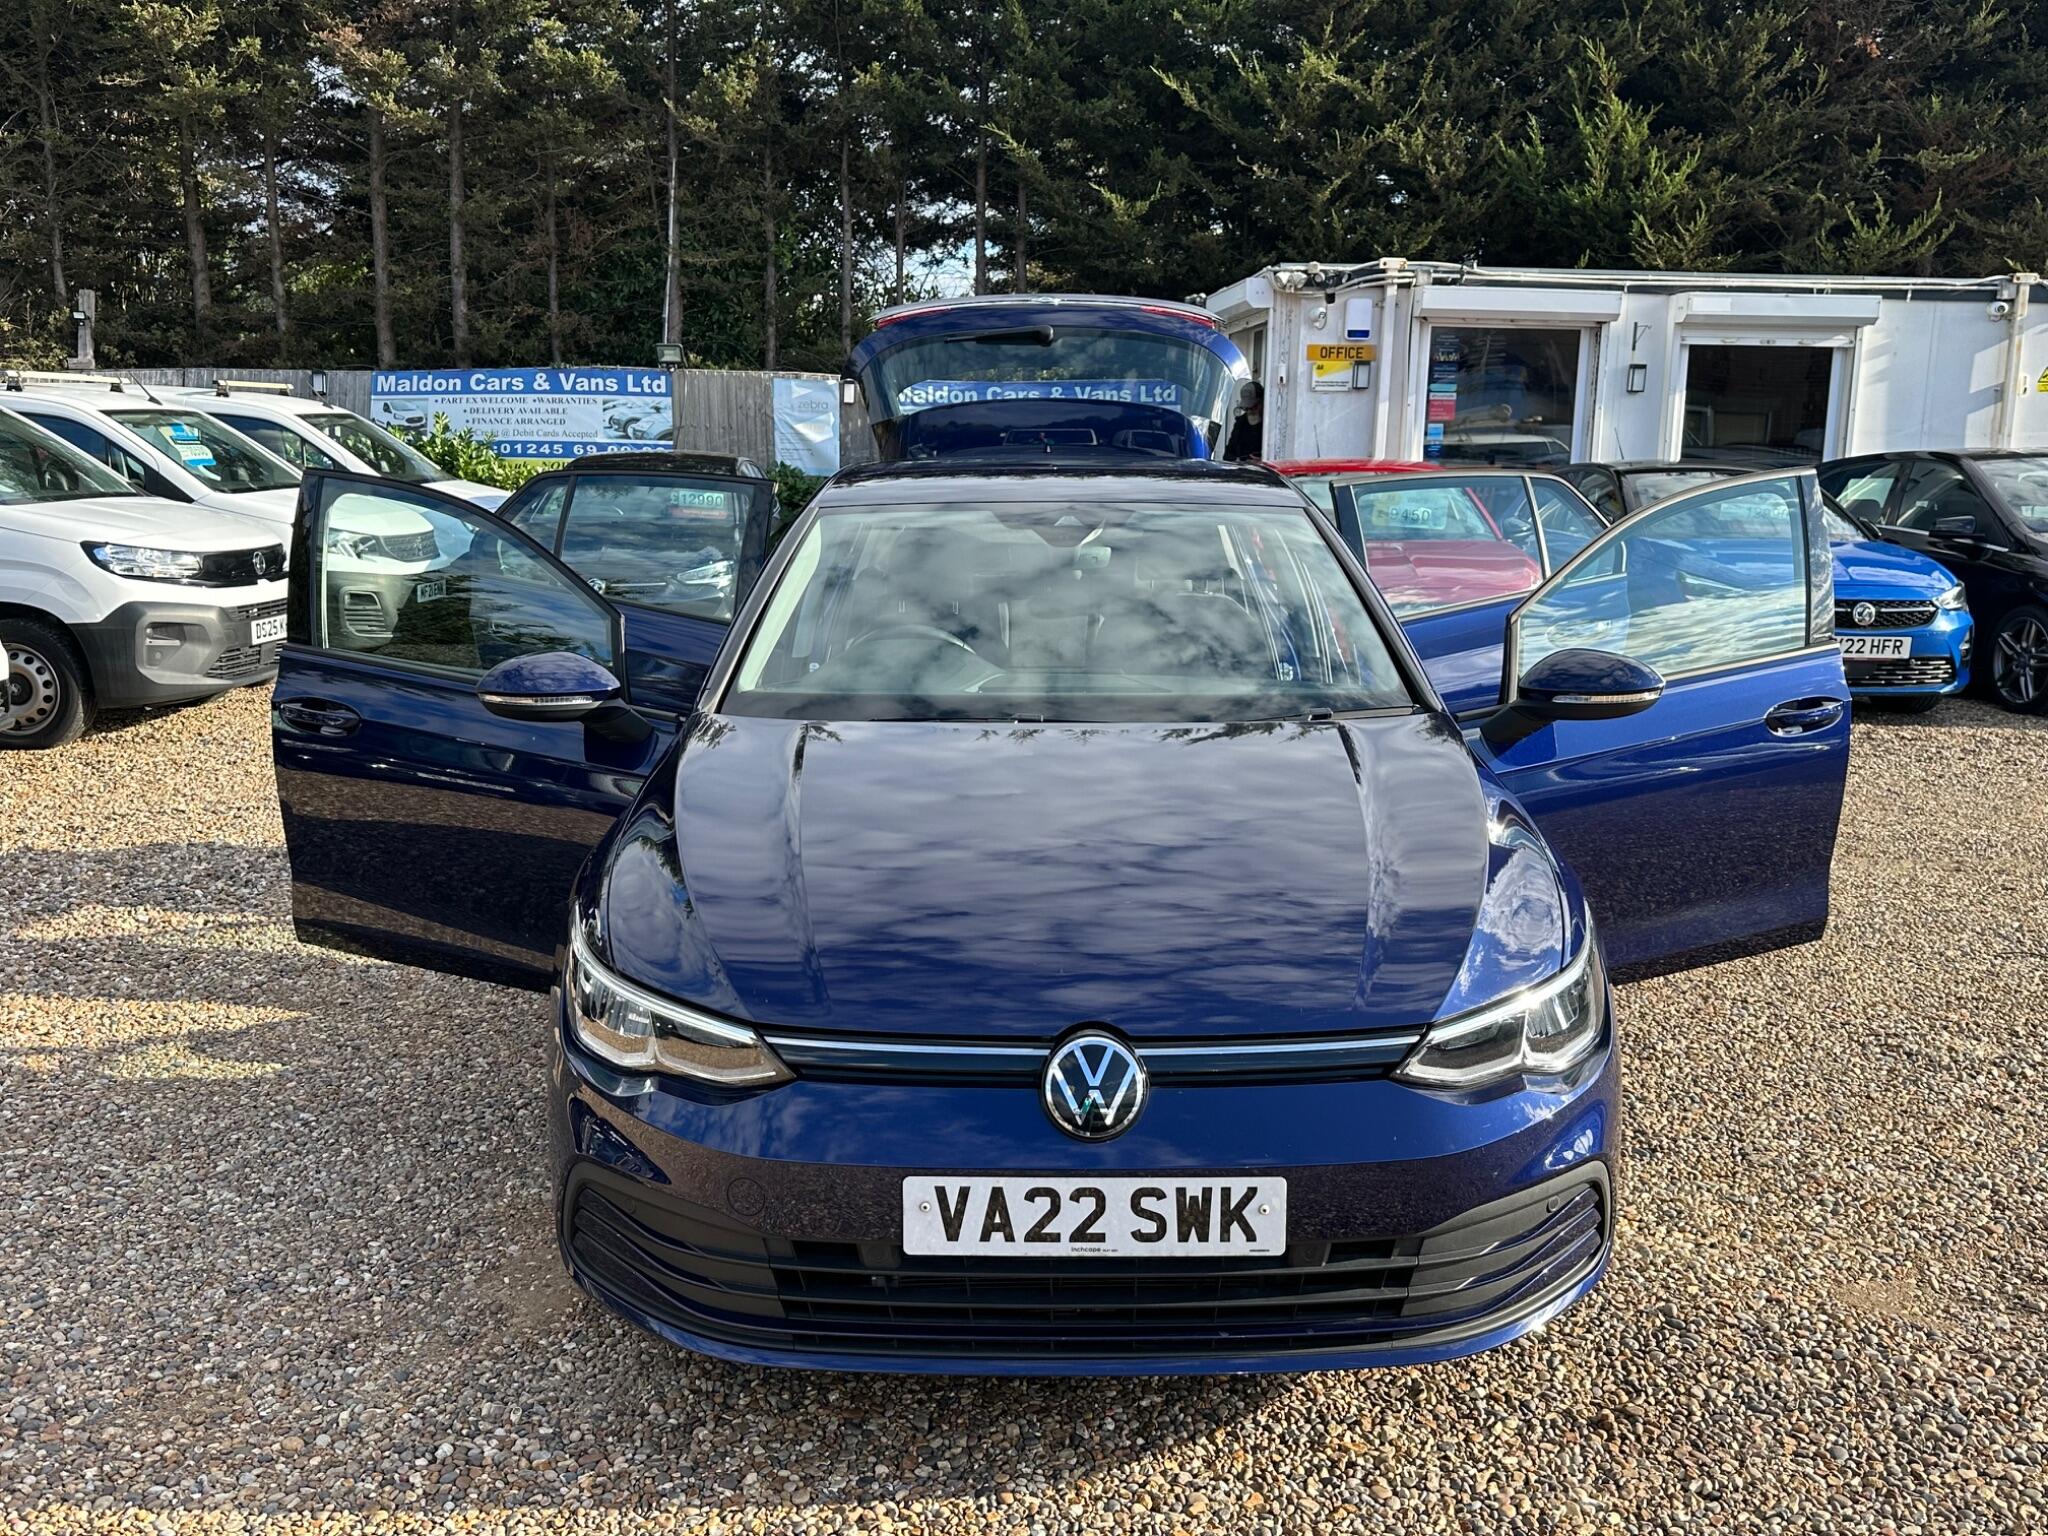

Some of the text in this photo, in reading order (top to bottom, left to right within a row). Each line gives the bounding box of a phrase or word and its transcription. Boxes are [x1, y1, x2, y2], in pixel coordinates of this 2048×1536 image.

[1320, 346, 1364, 359] OFFICE
[376, 372, 666, 393] Maldon Cars & Vans Ltd
[1075, 385, 1131, 402] Vans
[1140, 384, 1177, 403] Ltd
[469, 407, 568, 415] DELIVERY AVAILABLE
[798, 399, 829, 409] zebra
[515, 418, 566, 426] ARRANGED
[512, 429, 534, 437] Debit
[536, 429, 559, 438] Cards
[561, 429, 598, 439] Accepted
[255, 619, 278, 640] DS25
[1869, 638, 1904, 655] HFR
[933, 1184, 1259, 1244] VA22 SWK
